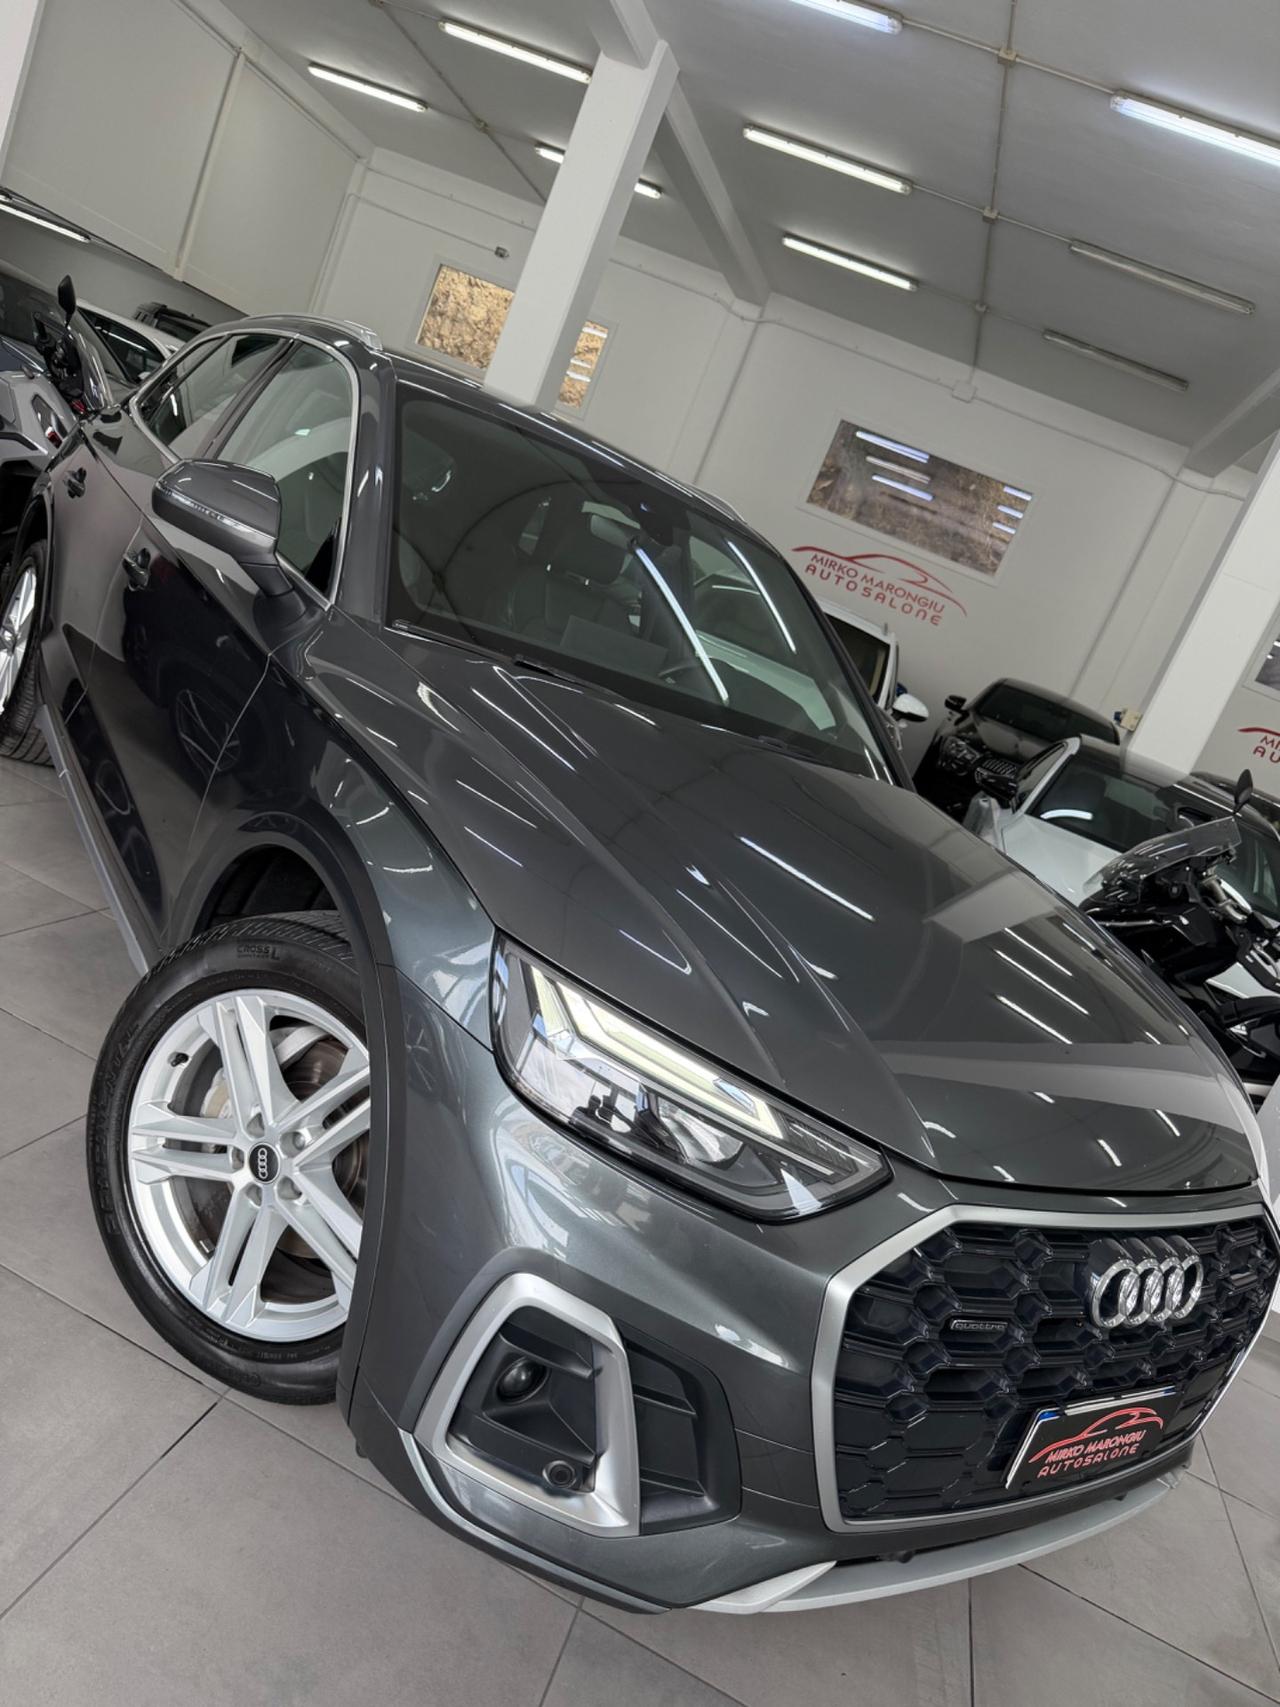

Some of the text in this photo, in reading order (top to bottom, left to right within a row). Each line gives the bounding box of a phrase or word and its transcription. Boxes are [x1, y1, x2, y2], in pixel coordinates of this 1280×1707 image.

[804, 564, 942, 626] AUTOSALONE
[810, 554, 945, 614] MIRKO MARONGIU
[1037, 1443, 1140, 1479] AUTOSALONE
[1045, 1430, 1147, 1464] MIRKO MARONGIU
